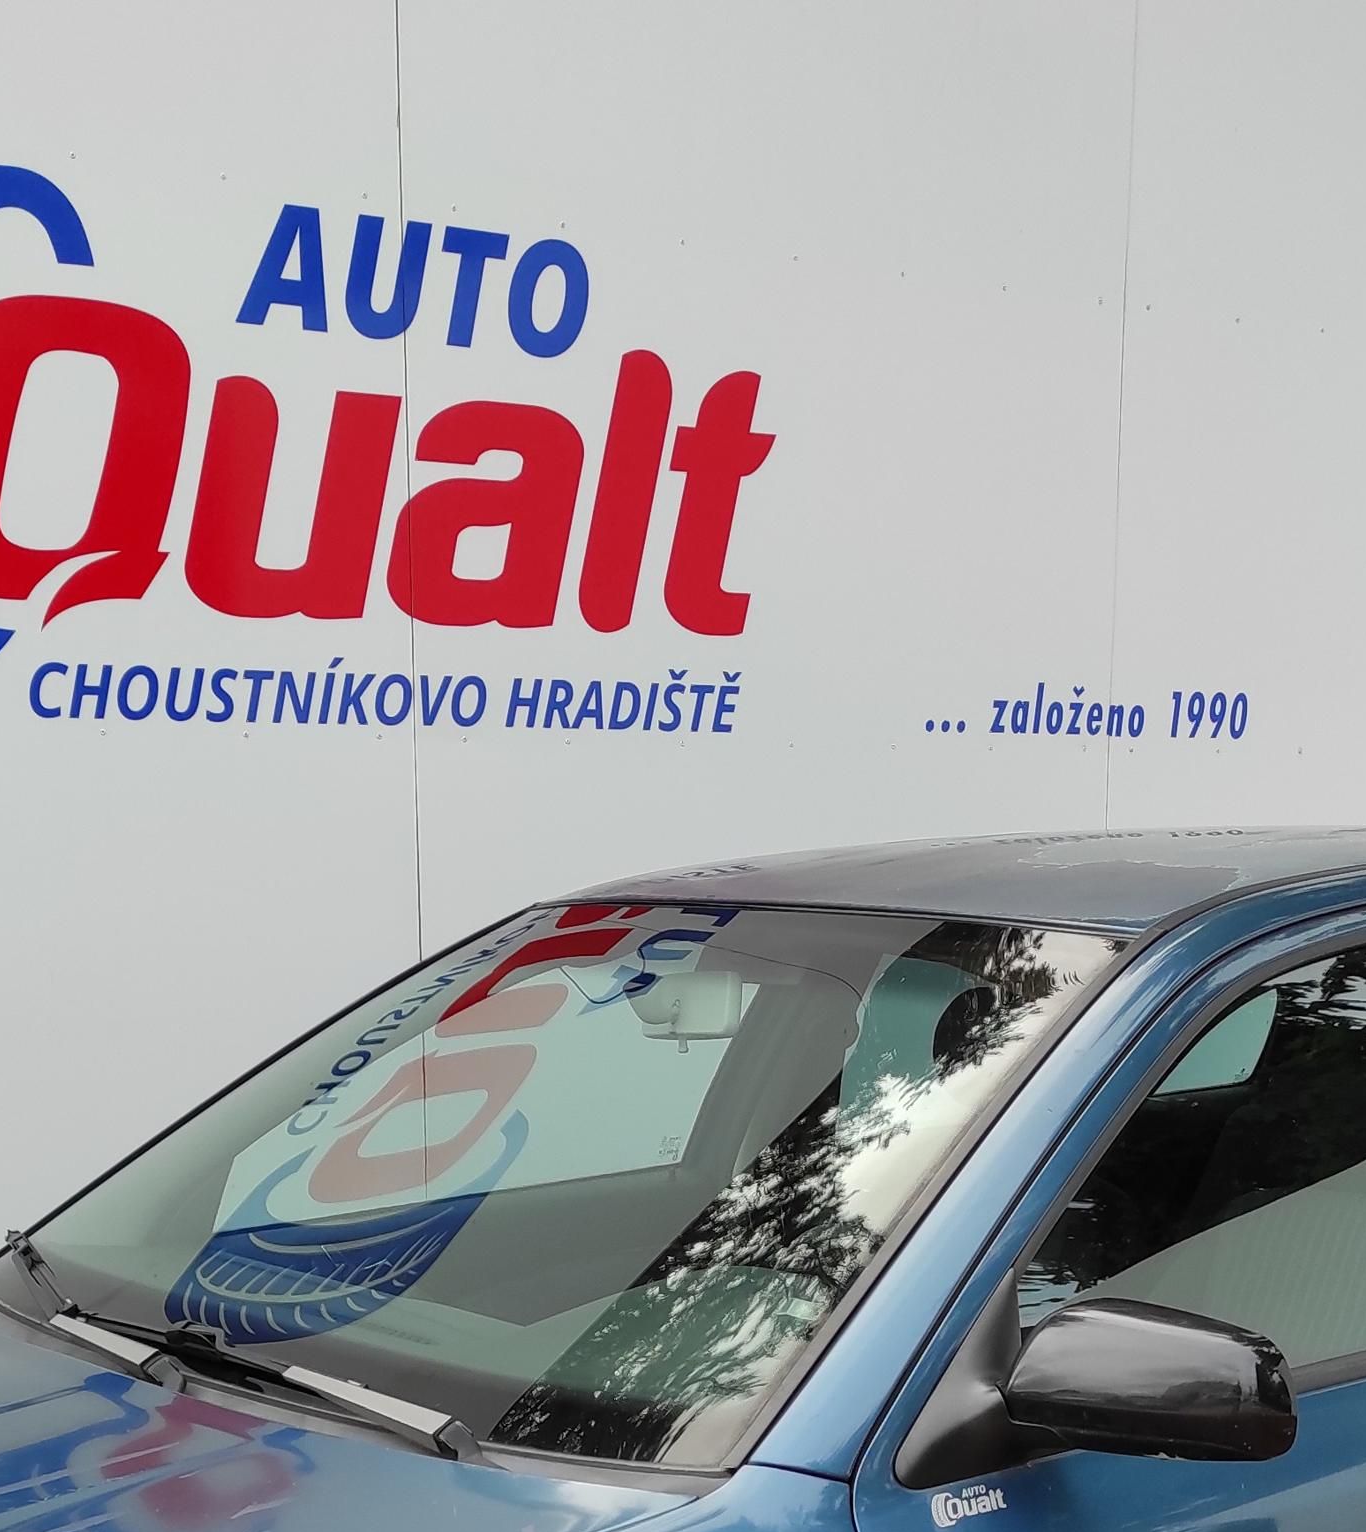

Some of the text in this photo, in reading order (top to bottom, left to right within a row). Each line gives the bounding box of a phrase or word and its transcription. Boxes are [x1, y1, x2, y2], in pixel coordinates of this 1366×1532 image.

[235, 203, 590, 359] AUTO
[29, 656, 740, 734] CHOUSTNÍKOVO HRADIŠTĚ
[988, 681, 1146, 738] založeno
[1170, 690, 1249, 741] 1990
[946, 1488, 1007, 1520] Qualt
[961, 1484, 987, 1499] AUTO
